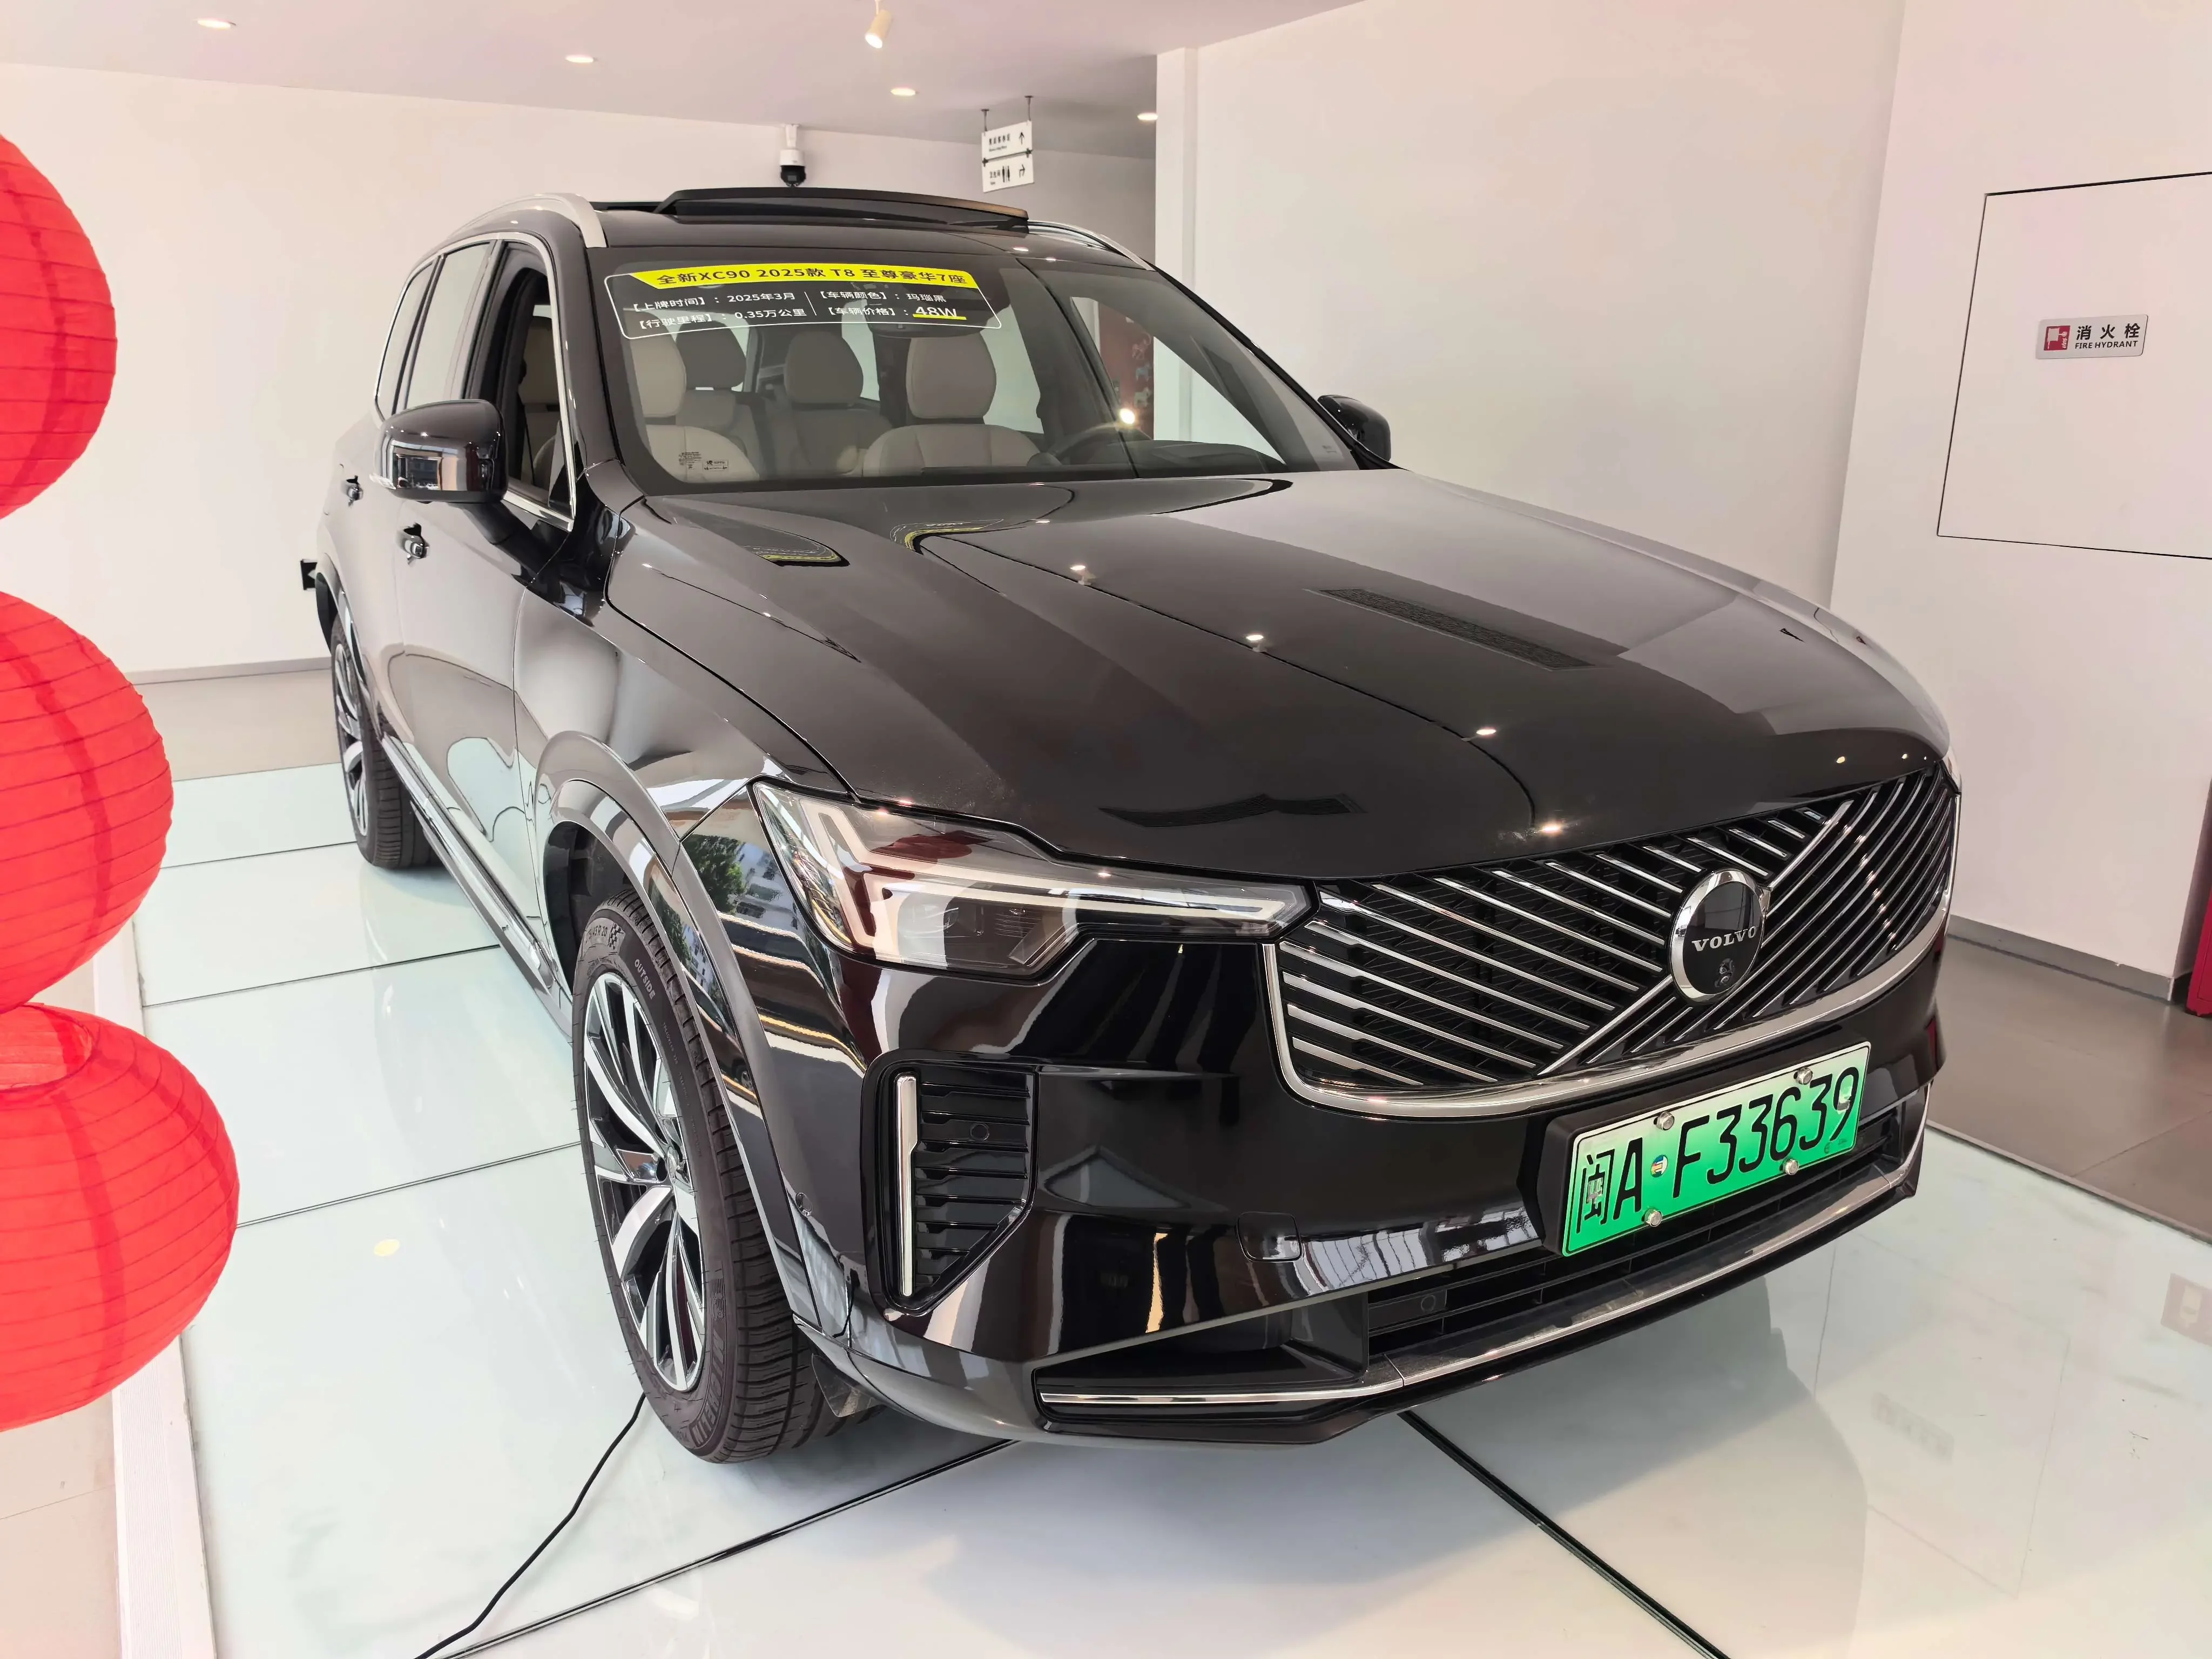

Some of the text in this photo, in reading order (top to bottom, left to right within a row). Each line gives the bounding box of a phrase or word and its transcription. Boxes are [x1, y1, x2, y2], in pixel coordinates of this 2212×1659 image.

[657, 270, 751, 285] 全新XC90
[756, 268, 826, 277] 2025款
[830, 269, 855, 277] T8
[2076, 323, 2141, 340] 消火栓
[2095, 340, 2139, 348] HYDRANT
[1691, 926, 1757, 952] VOLVO
[635, 959, 656, 1000] OUTSIDE
